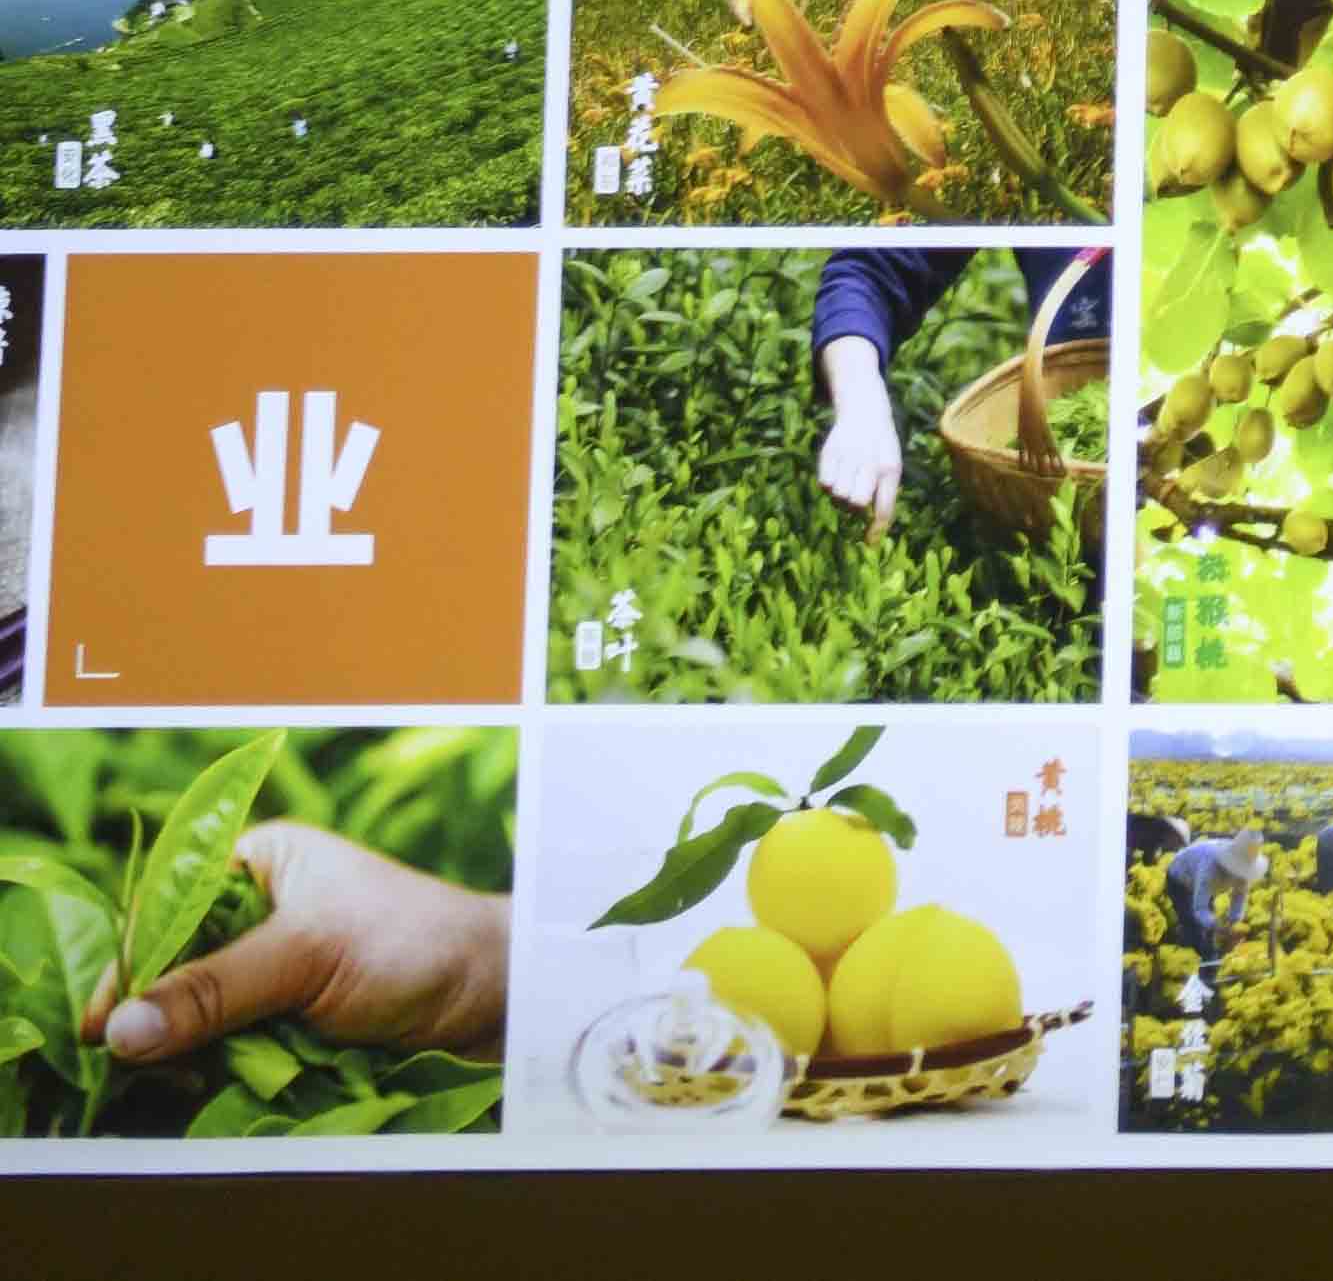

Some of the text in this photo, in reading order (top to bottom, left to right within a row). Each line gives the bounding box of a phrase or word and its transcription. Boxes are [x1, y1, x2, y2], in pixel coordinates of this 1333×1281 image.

[84, 109, 121, 190] 黑茶
[204, 391, 381, 565] 业
[606, 588, 644, 672] 茶叶
[1033, 757, 1068, 839] 黄桃
